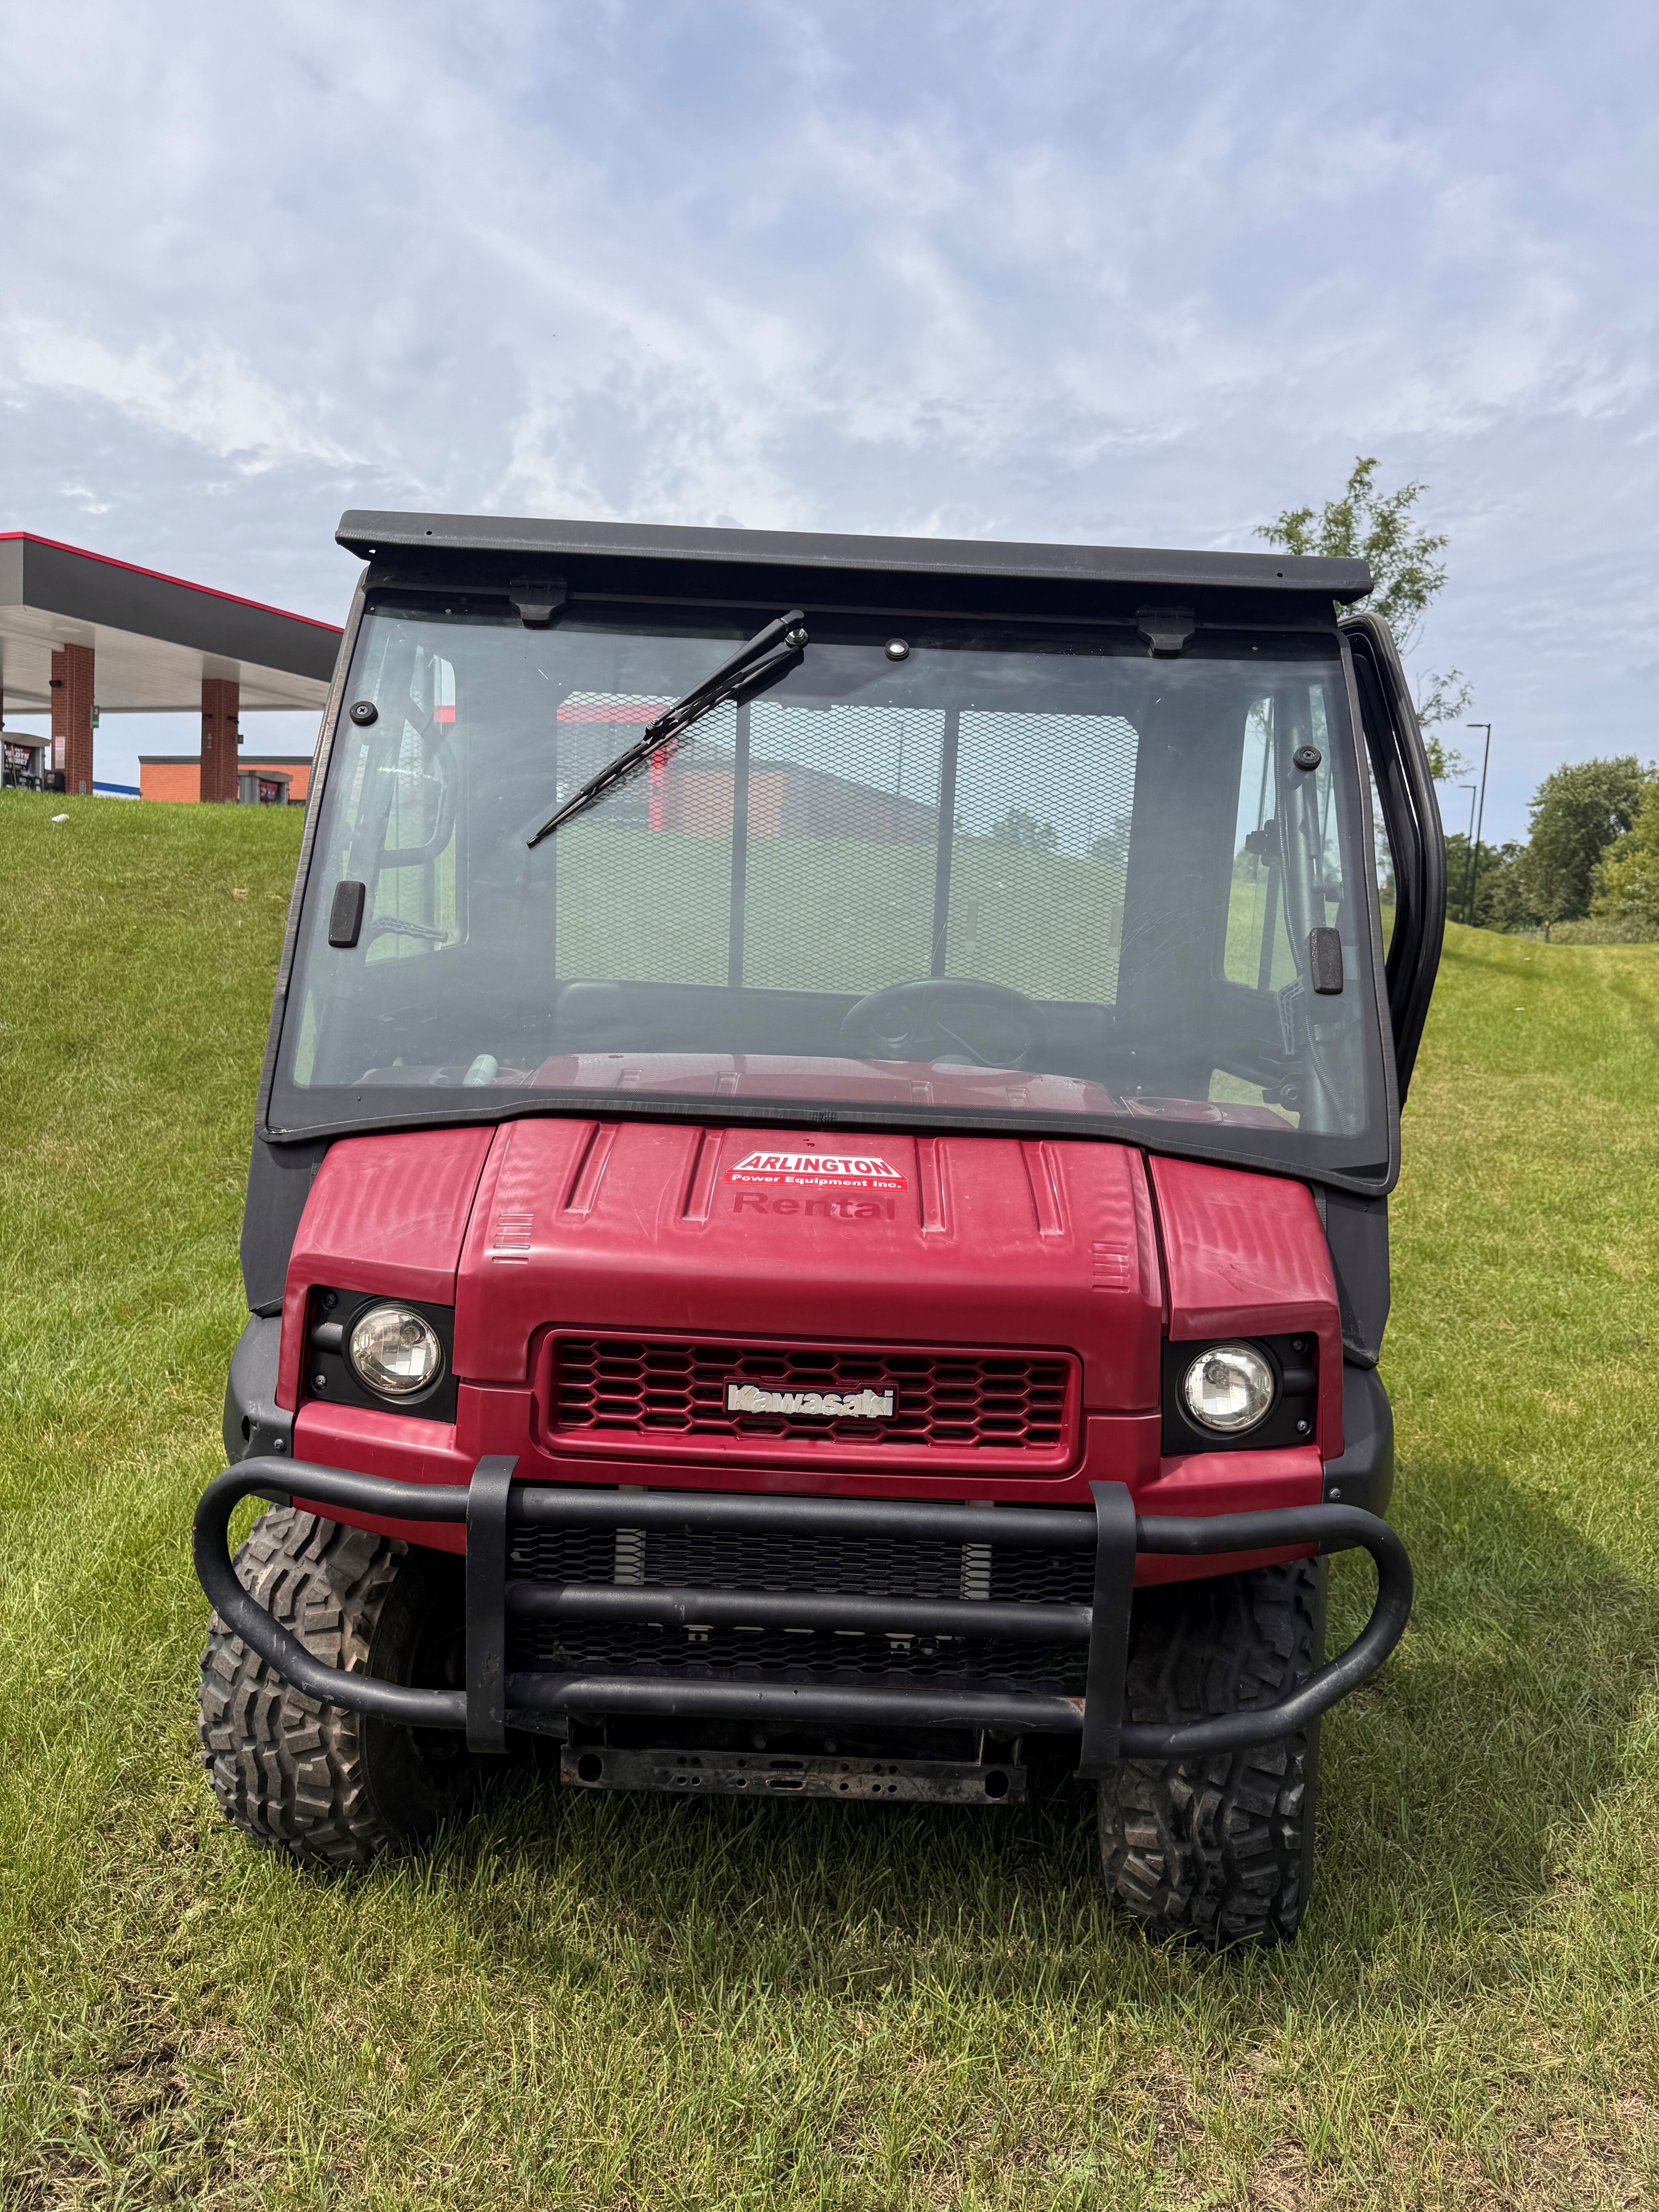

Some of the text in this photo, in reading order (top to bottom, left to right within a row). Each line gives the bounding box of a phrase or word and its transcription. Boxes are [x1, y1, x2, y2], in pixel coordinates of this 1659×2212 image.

[741, 1156, 893, 1175] ARLINGTON
[732, 1174, 780, 1182] Power
[785, 1176, 868, 1187] Equipment
[733, 1192, 895, 1220] Rental
[728, 1384, 893, 1418] Kawasaki
